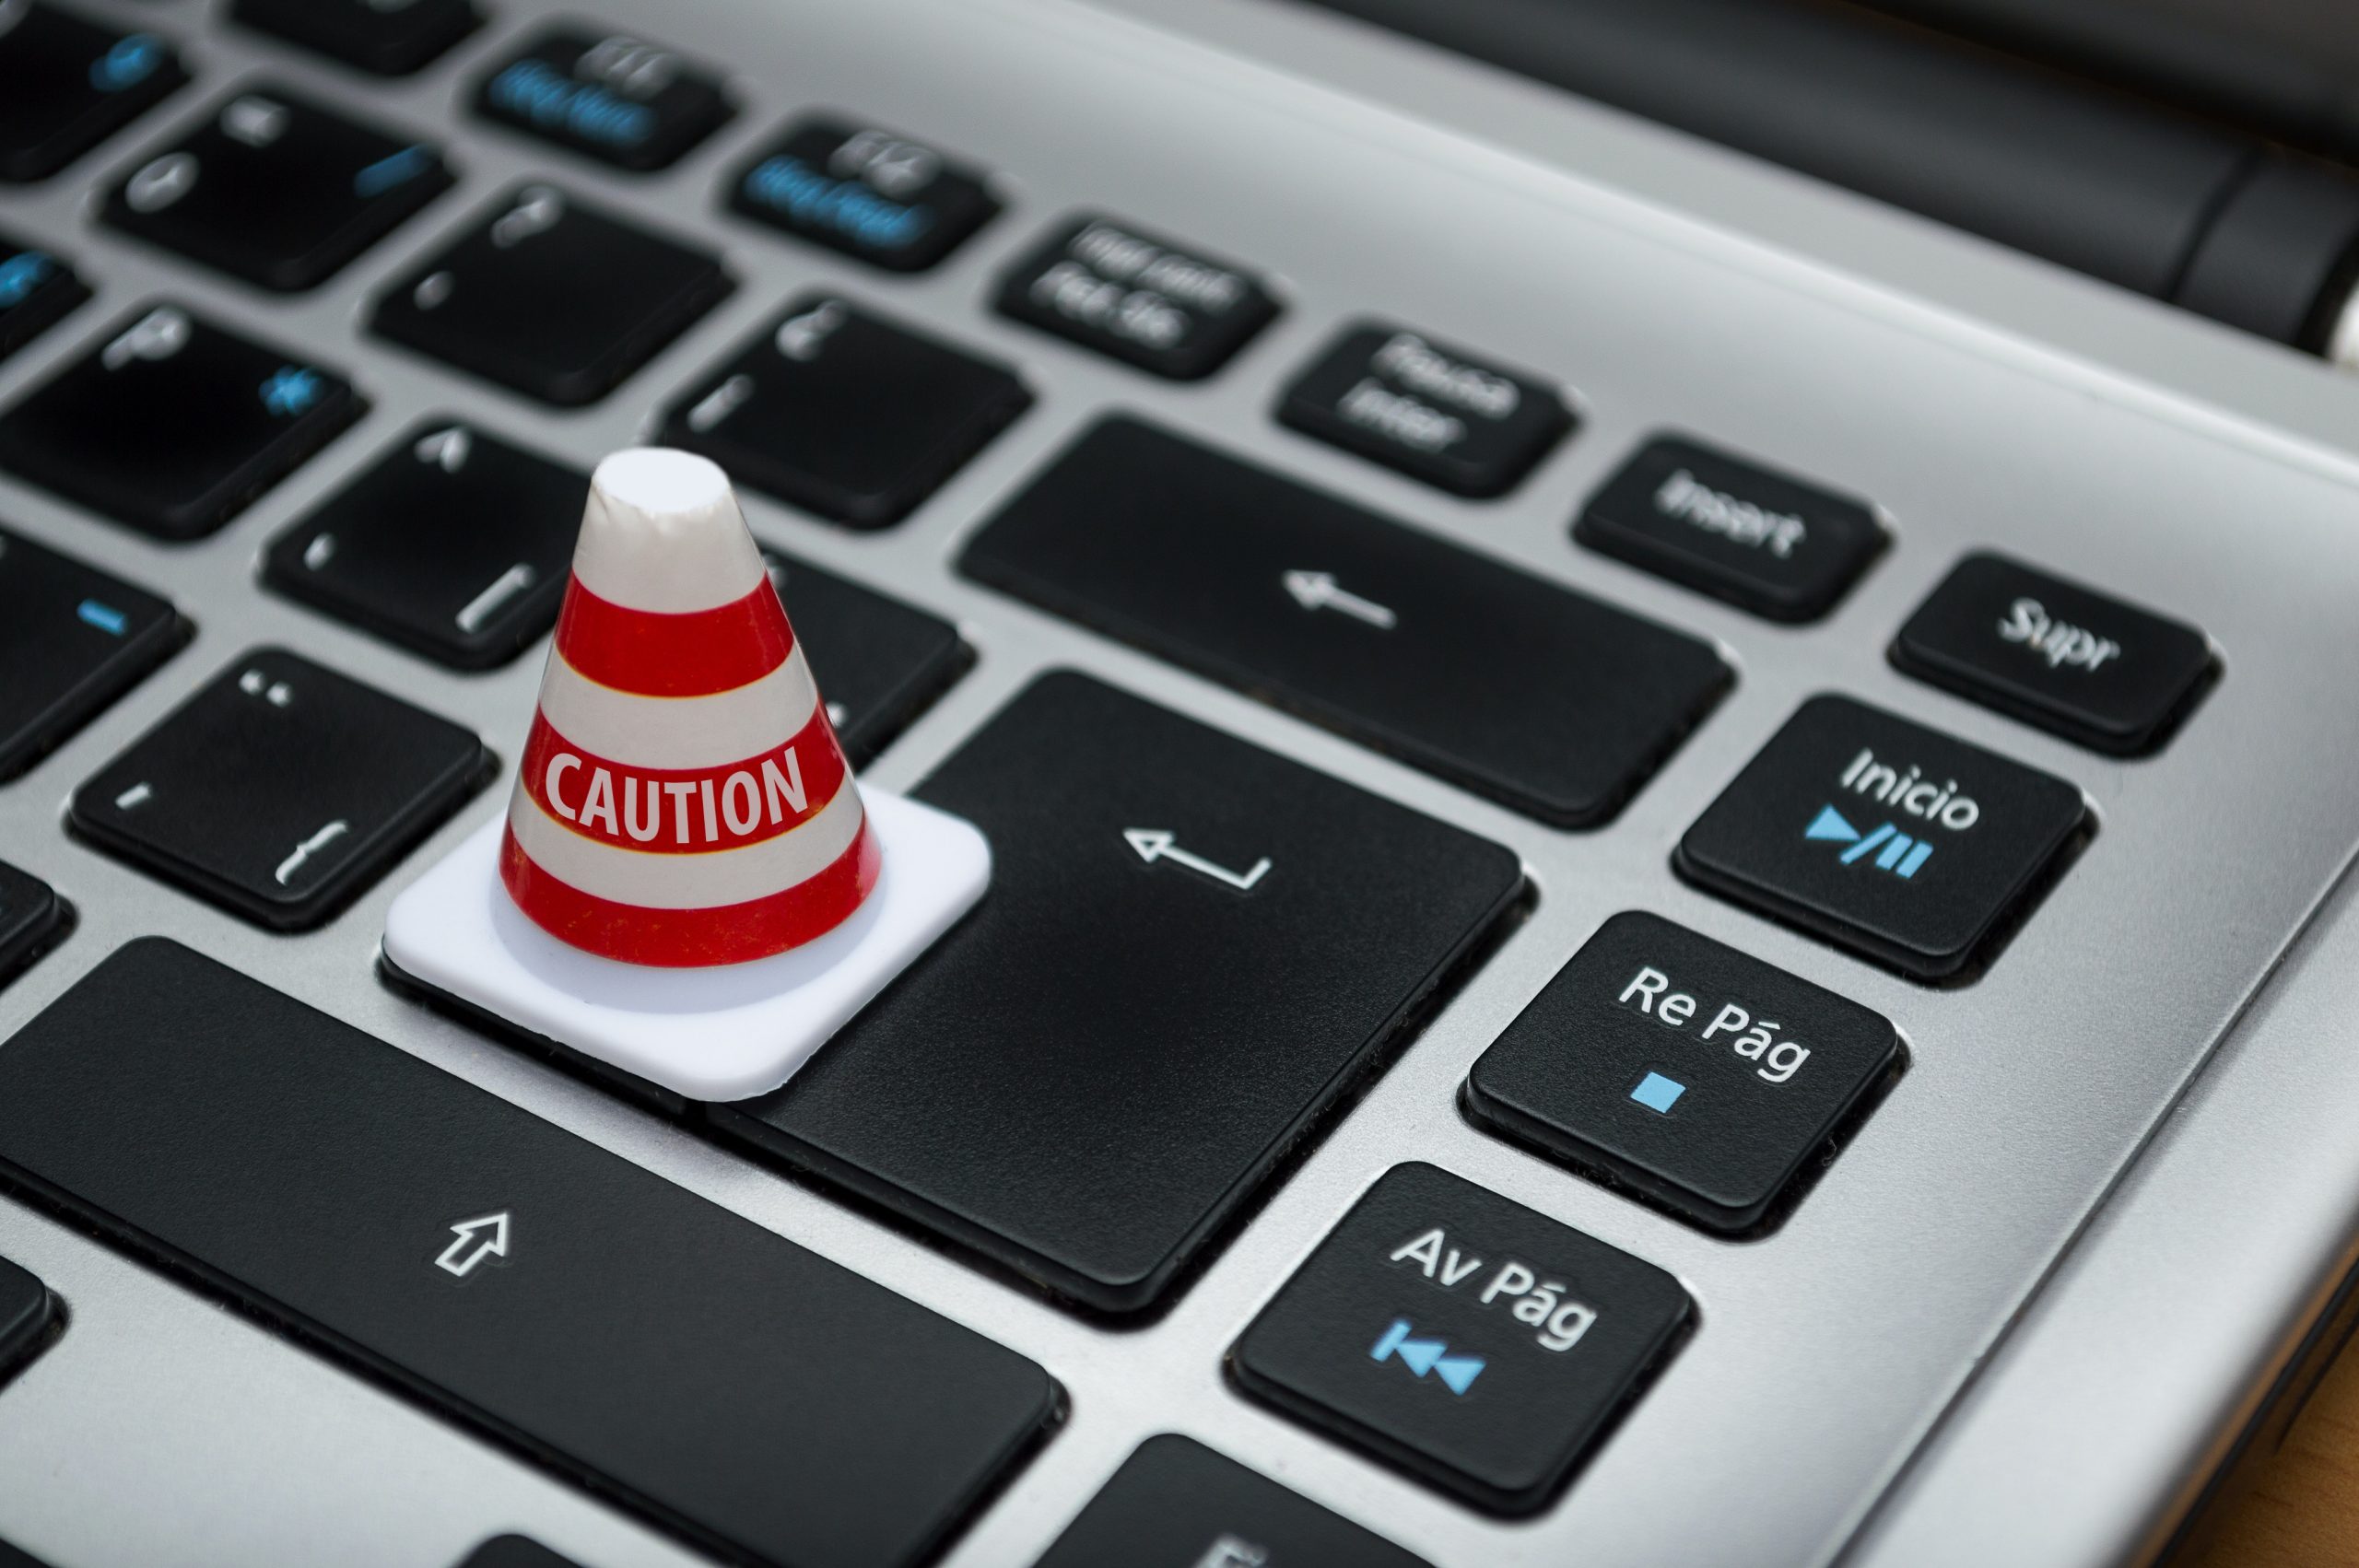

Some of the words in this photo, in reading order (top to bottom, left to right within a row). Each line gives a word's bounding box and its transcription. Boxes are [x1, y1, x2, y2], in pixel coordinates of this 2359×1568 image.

[1655, 468, 1806, 558] Insert
[1996, 597, 2120, 673] Supr
[546, 746, 808, 844] CAUTION
[1841, 747, 1979, 830] Inicio
[1619, 966, 1696, 1026] Re
[1702, 1003, 1811, 1082] Pág
[1390, 1228, 1482, 1287] Av
[1480, 1260, 1597, 1352] Pág
